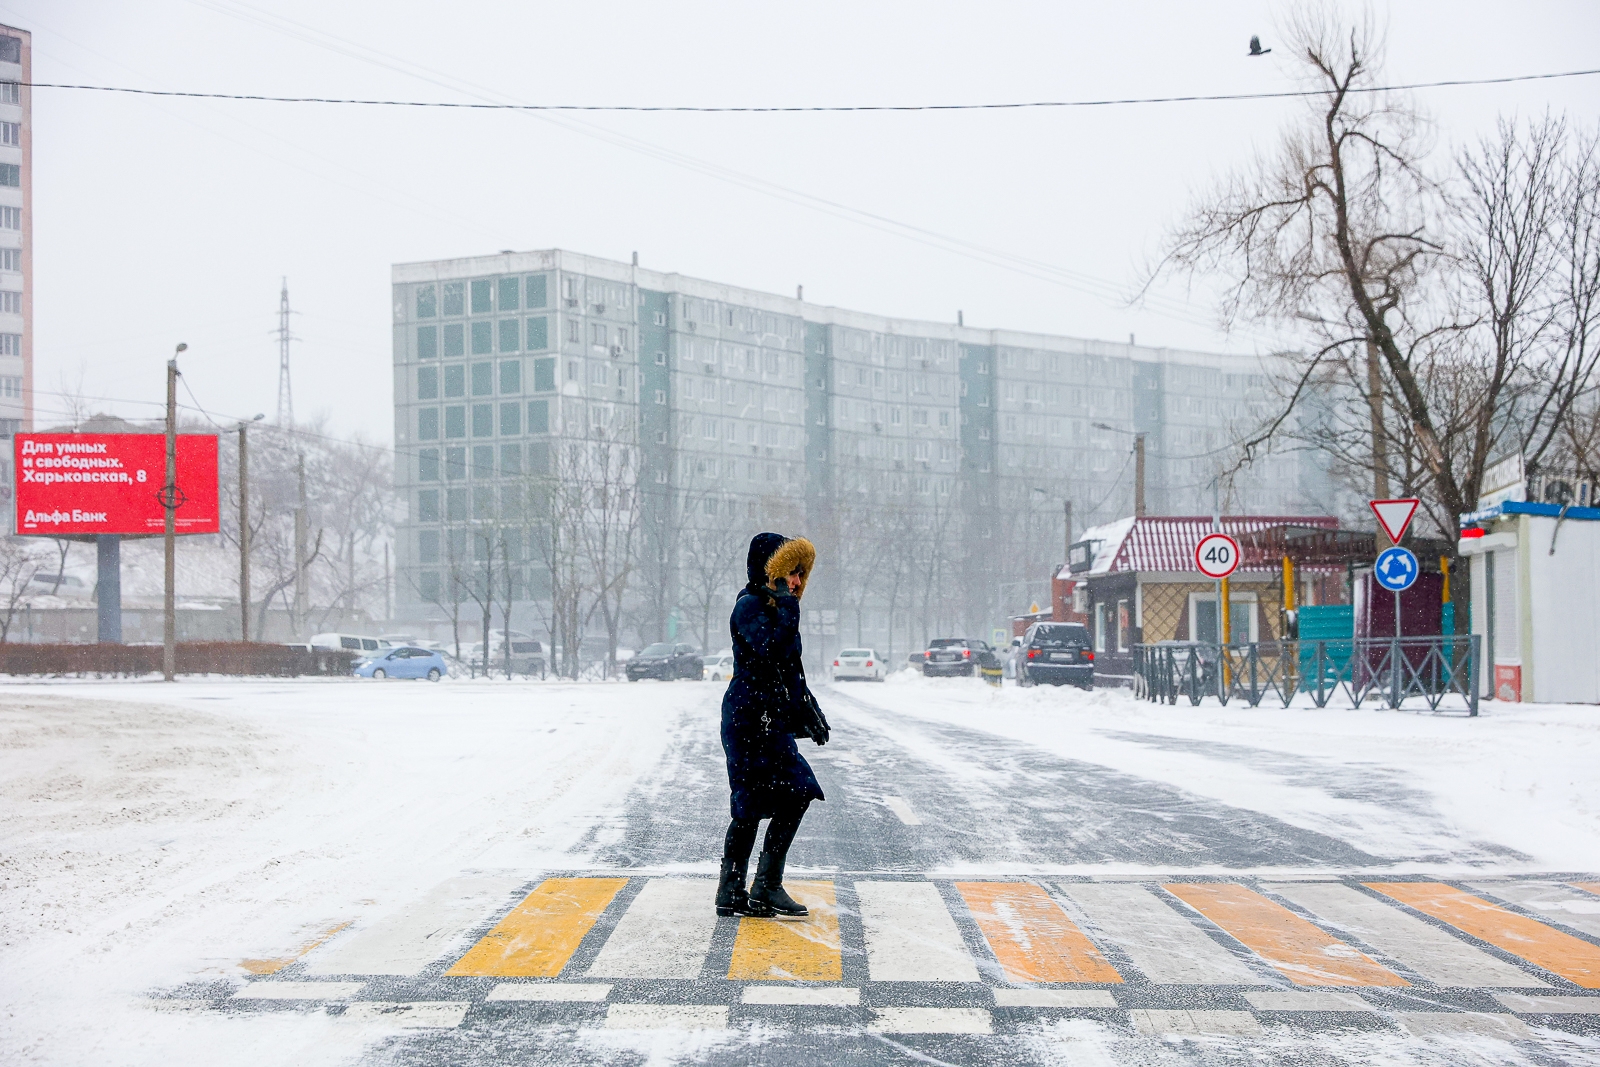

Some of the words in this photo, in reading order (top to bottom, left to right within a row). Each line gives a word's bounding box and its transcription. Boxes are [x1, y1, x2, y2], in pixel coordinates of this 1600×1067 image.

[22, 440, 53, 455] Для
[56, 442, 107, 456] умных
[23, 458, 34, 468] и
[36, 456, 124, 469] свободных.
[23, 470, 133, 485] Харьковская,
[136, 471, 147, 483] 8
[24, 509, 71, 526] Альфа
[72, 509, 108, 523] Банк
[1204, 546, 1230, 564] 40
